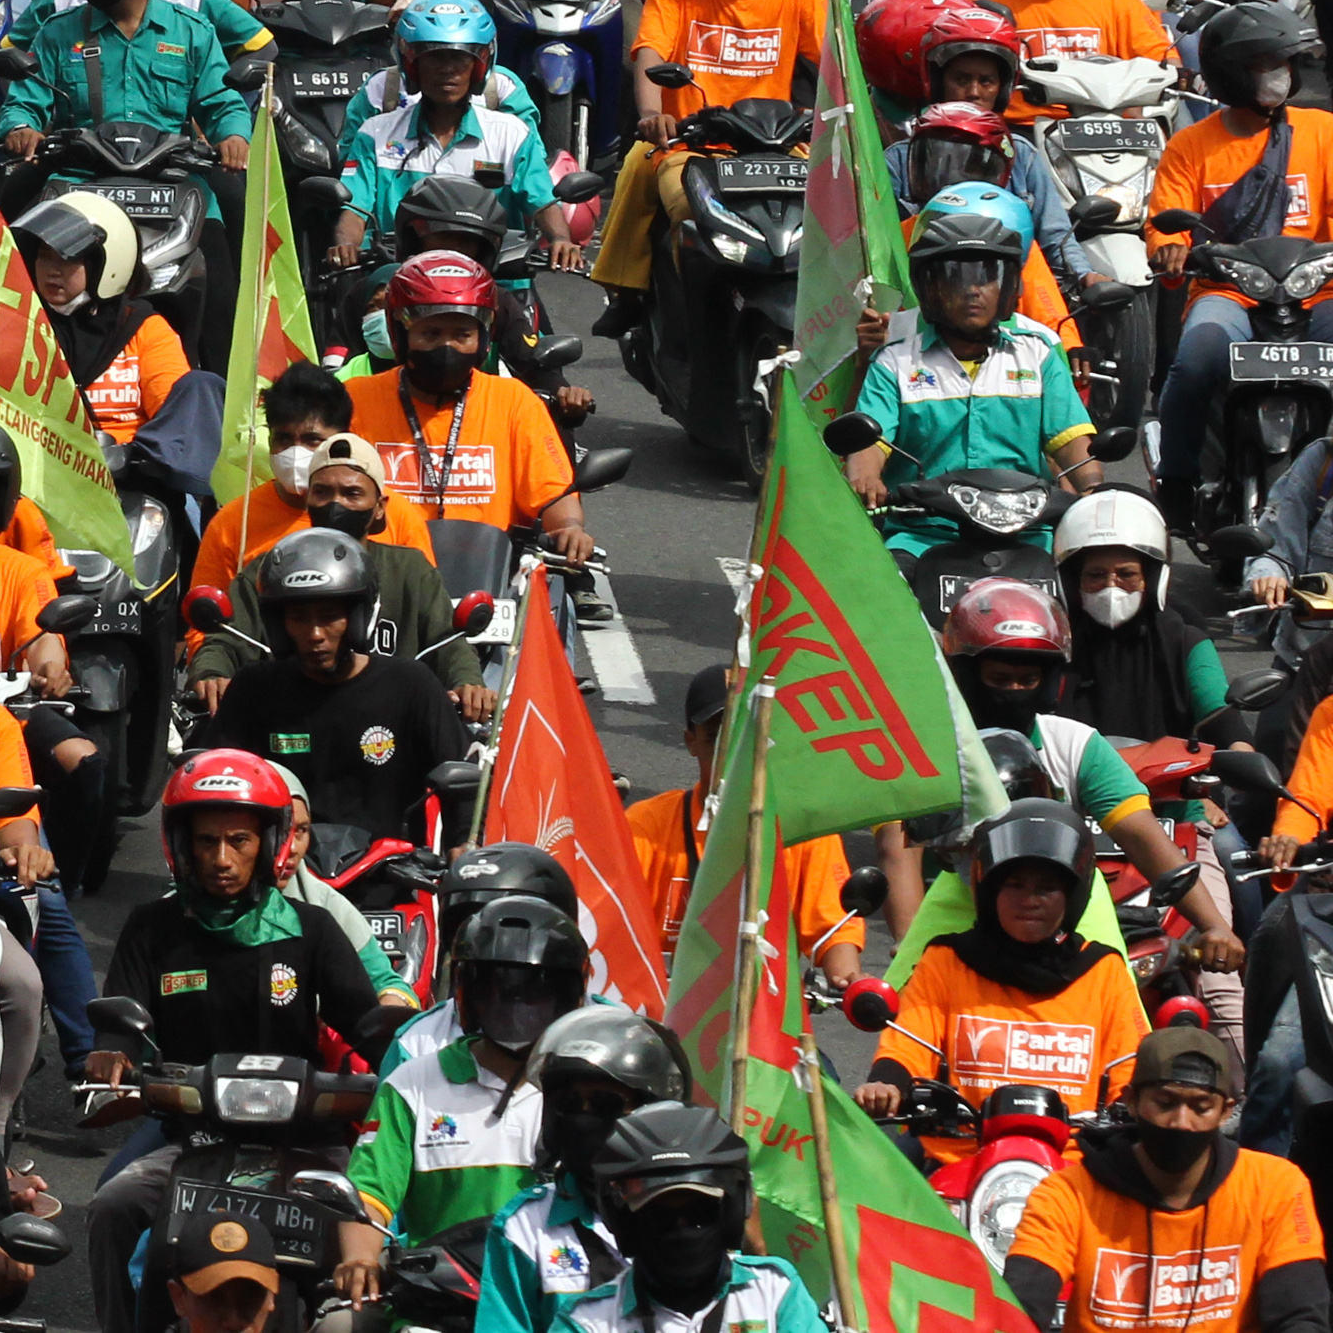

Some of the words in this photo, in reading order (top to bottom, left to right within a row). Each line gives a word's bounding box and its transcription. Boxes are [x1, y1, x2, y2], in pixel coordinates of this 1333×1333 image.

[725, 32, 780, 50] Partai
[1044, 31, 1099, 50] Partai
[724, 46, 780, 64] Buruh
[292, 70, 303, 86] L
[311, 69, 349, 87] 6615
[1061, 122, 1072, 137] L
[1083, 121, 1124, 137] 6595
[722, 162, 734, 178] N
[743, 162, 783, 178] 2212
[150, 185, 173, 203] NY
[1234, 346, 1246, 362] L
[1260, 346, 1301, 363] 4678
[467, 495, 491, 504] CLASS
[285, 571, 326, 584] INK
[116, 602, 141, 618] QX
[199, 777, 242, 788] INK
[1010, 1027, 1091, 1055] Partai
[1010, 1051, 1089, 1077] Buruh
[744, 1106, 814, 1162] PUK
[651, 1152, 690, 1161] HONDA
[1155, 1254, 1240, 1288] Partai
[1155, 1276, 1240, 1309] Buruh
